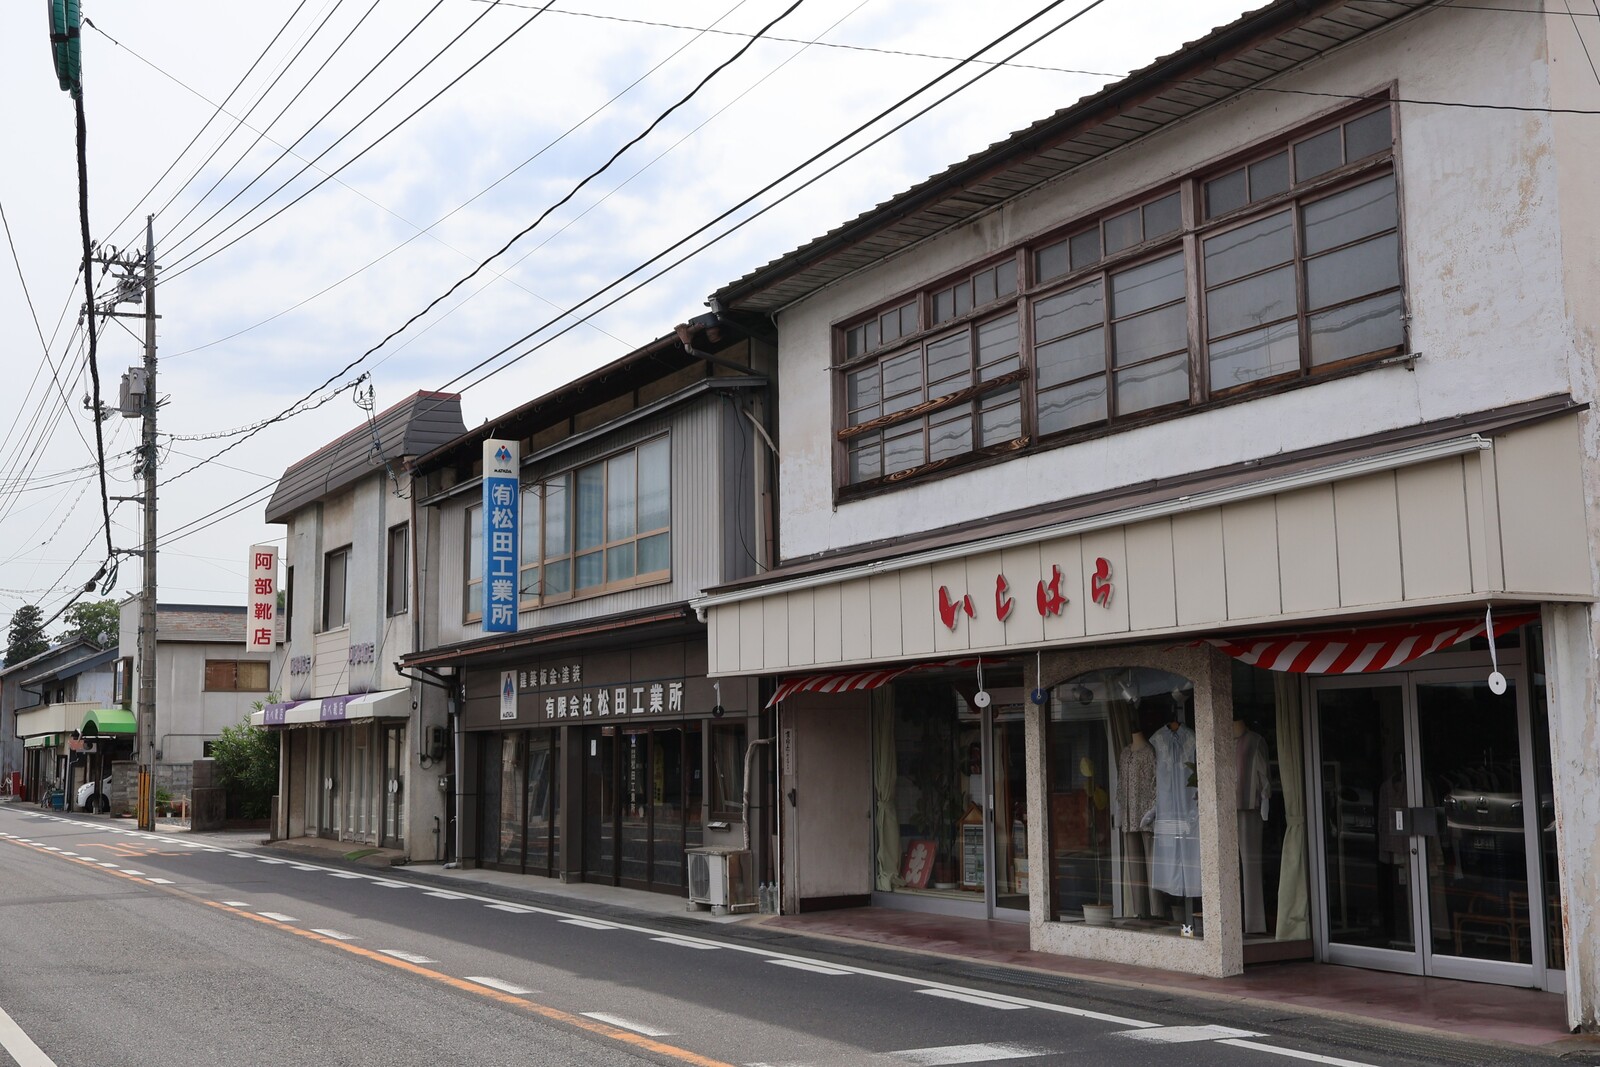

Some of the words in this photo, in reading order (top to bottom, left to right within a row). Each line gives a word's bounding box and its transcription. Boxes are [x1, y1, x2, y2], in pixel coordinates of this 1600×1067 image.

[491, 483, 514, 626] (有)松田工業所
[938, 557, 1113, 631] いしはら
[253, 552, 273, 645] 阿部靴店
[545, 681, 683, 719] 有限会社松田工業所
